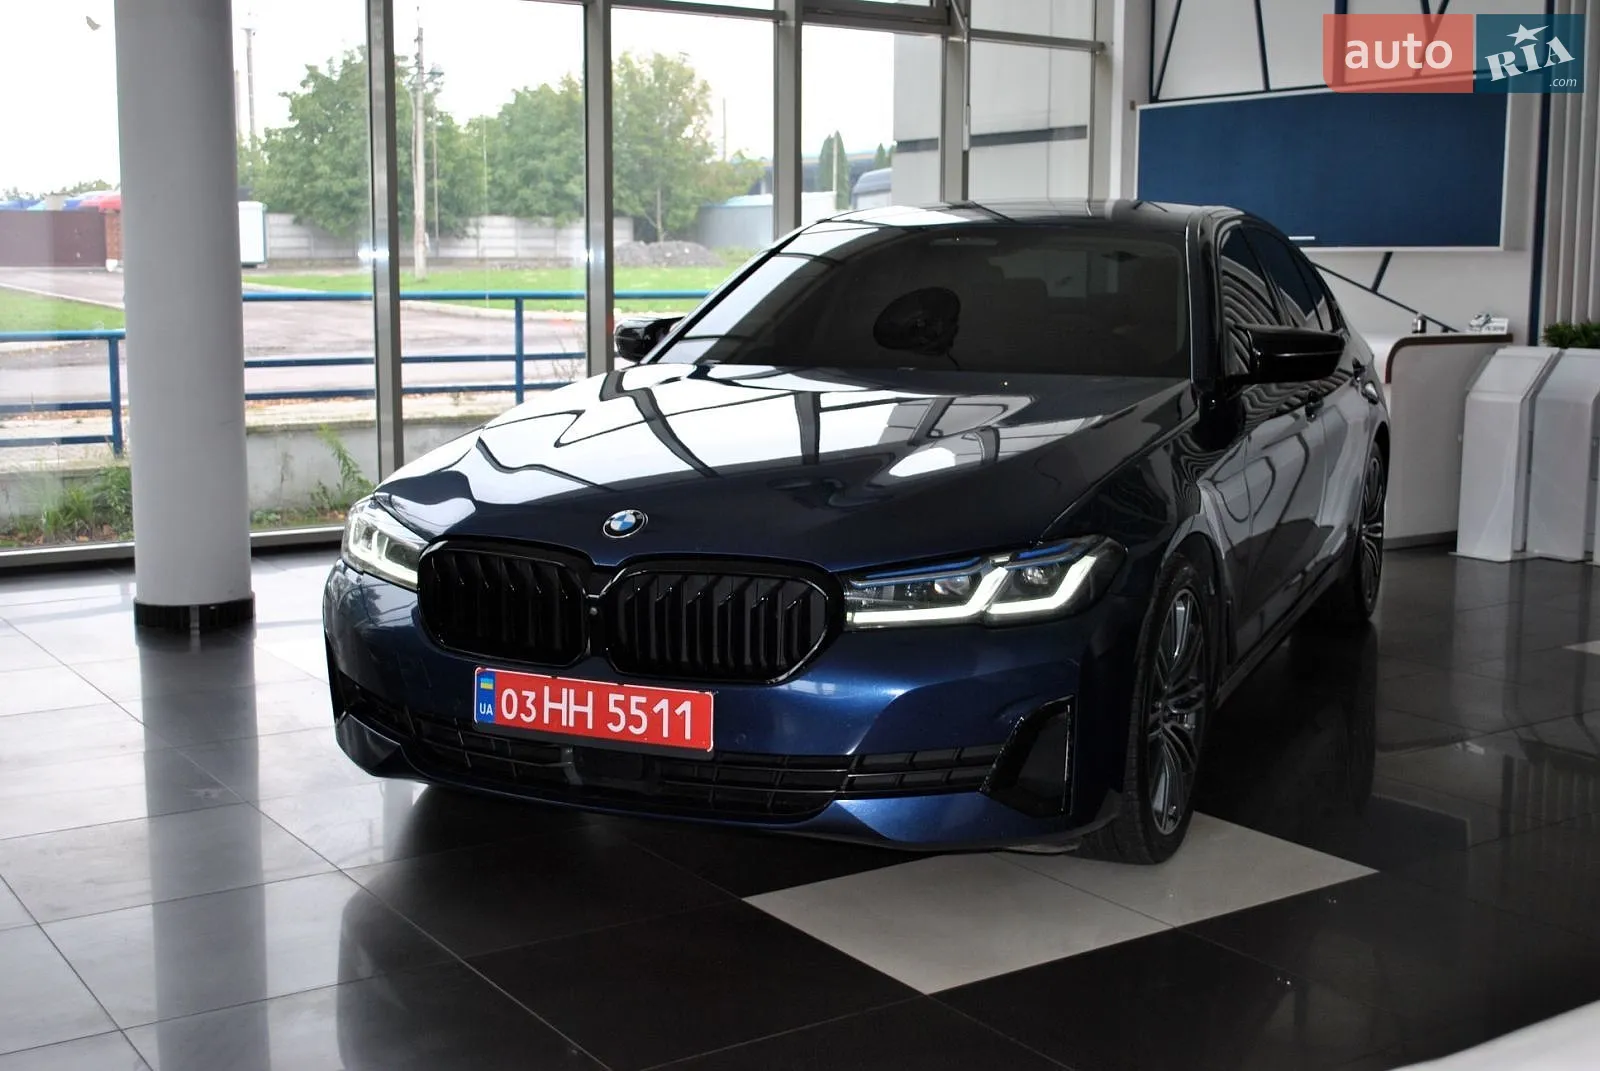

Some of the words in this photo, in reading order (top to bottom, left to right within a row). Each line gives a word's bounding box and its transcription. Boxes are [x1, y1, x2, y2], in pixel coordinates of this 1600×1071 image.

[479, 702, 494, 716] UA
[501, 688, 537, 723] 03
[543, 686, 594, 730] HH
[606, 692, 692, 740] 5511
